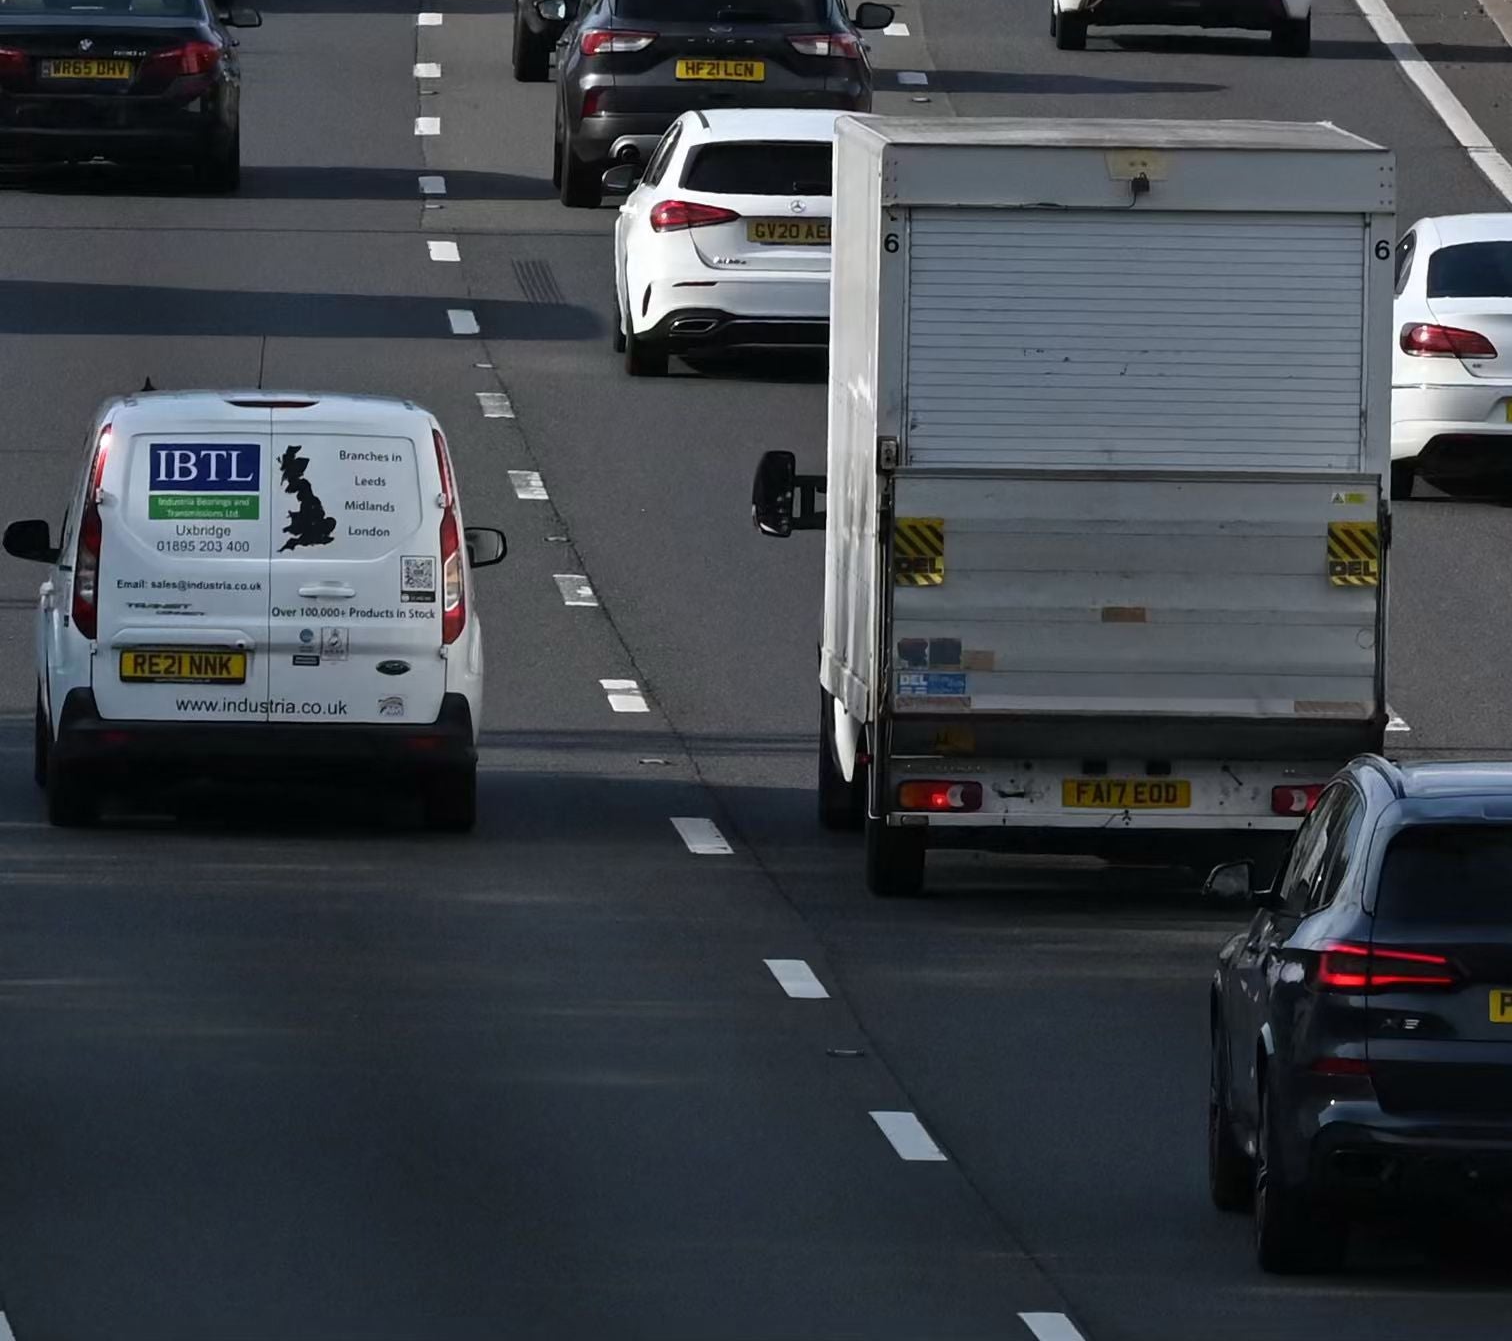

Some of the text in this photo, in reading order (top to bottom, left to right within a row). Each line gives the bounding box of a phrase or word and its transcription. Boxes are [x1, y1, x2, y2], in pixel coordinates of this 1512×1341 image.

[52, 60, 94, 77] WR65
[685, 61, 720, 76] HF21
[755, 222, 800, 239] GV20
[884, 232, 899, 254] 6
[1374, 239, 1390, 261] 6
[339, 449, 402, 462] Branches in
[156, 449, 256, 482] IBTL
[354, 475, 386, 487] Leeds
[344, 500, 395, 512] Midlands
[175, 524, 232, 538] Uxbridge
[348, 525, 390, 537] London
[156, 540, 250, 553] 01895 203 400
[893, 557, 942, 574] DEL
[1329, 560, 1377, 577] DEL
[117, 578, 262, 591] Email: sales@industria.co.uk
[272, 606, 436, 620] Over 100,000+ Products in Stock
[132, 654, 233, 677] RE21 NNK
[176, 697, 348, 715] www.industria.co.uk
[1075, 782, 1127, 804] FA17
